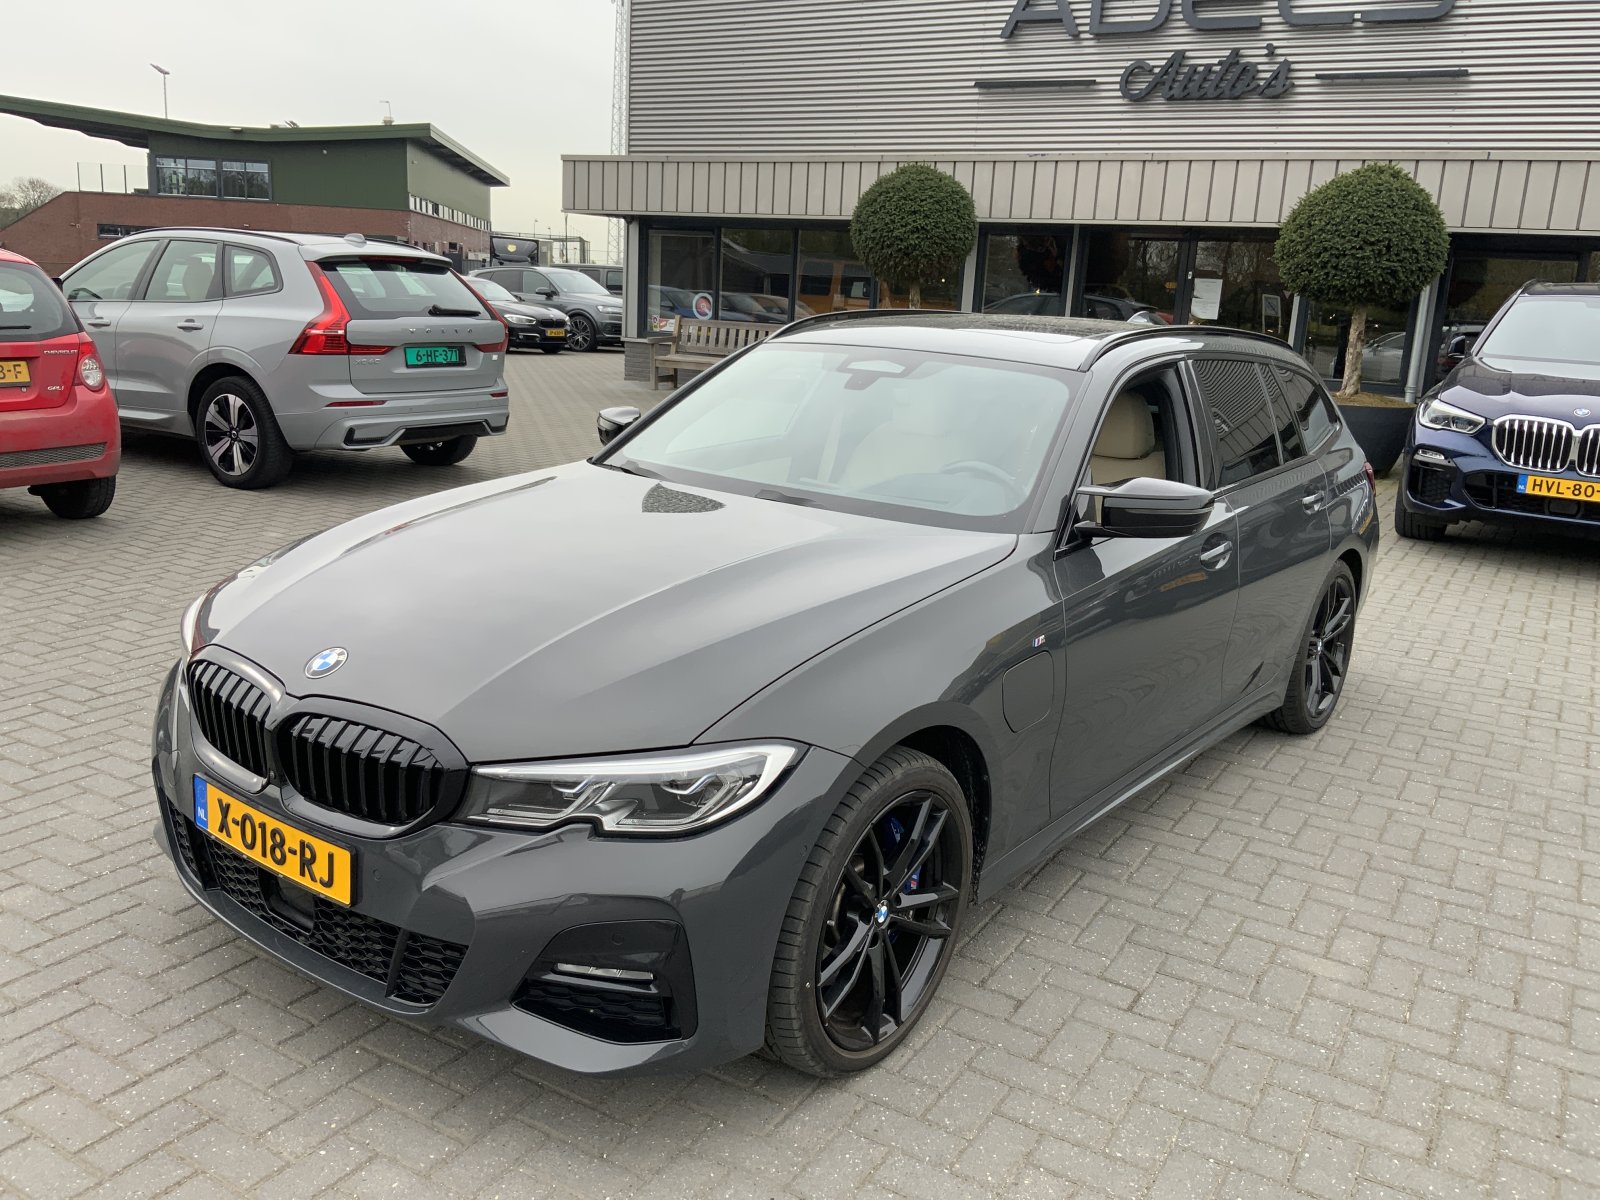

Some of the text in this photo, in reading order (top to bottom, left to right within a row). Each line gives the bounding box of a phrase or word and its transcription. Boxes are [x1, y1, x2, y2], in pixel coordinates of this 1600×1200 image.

[1119, 43, 1295, 101] Auto's
[415, 349, 459, 363] 6-HF-371
[197, 797, 335, 888] NL X-018-RJ
